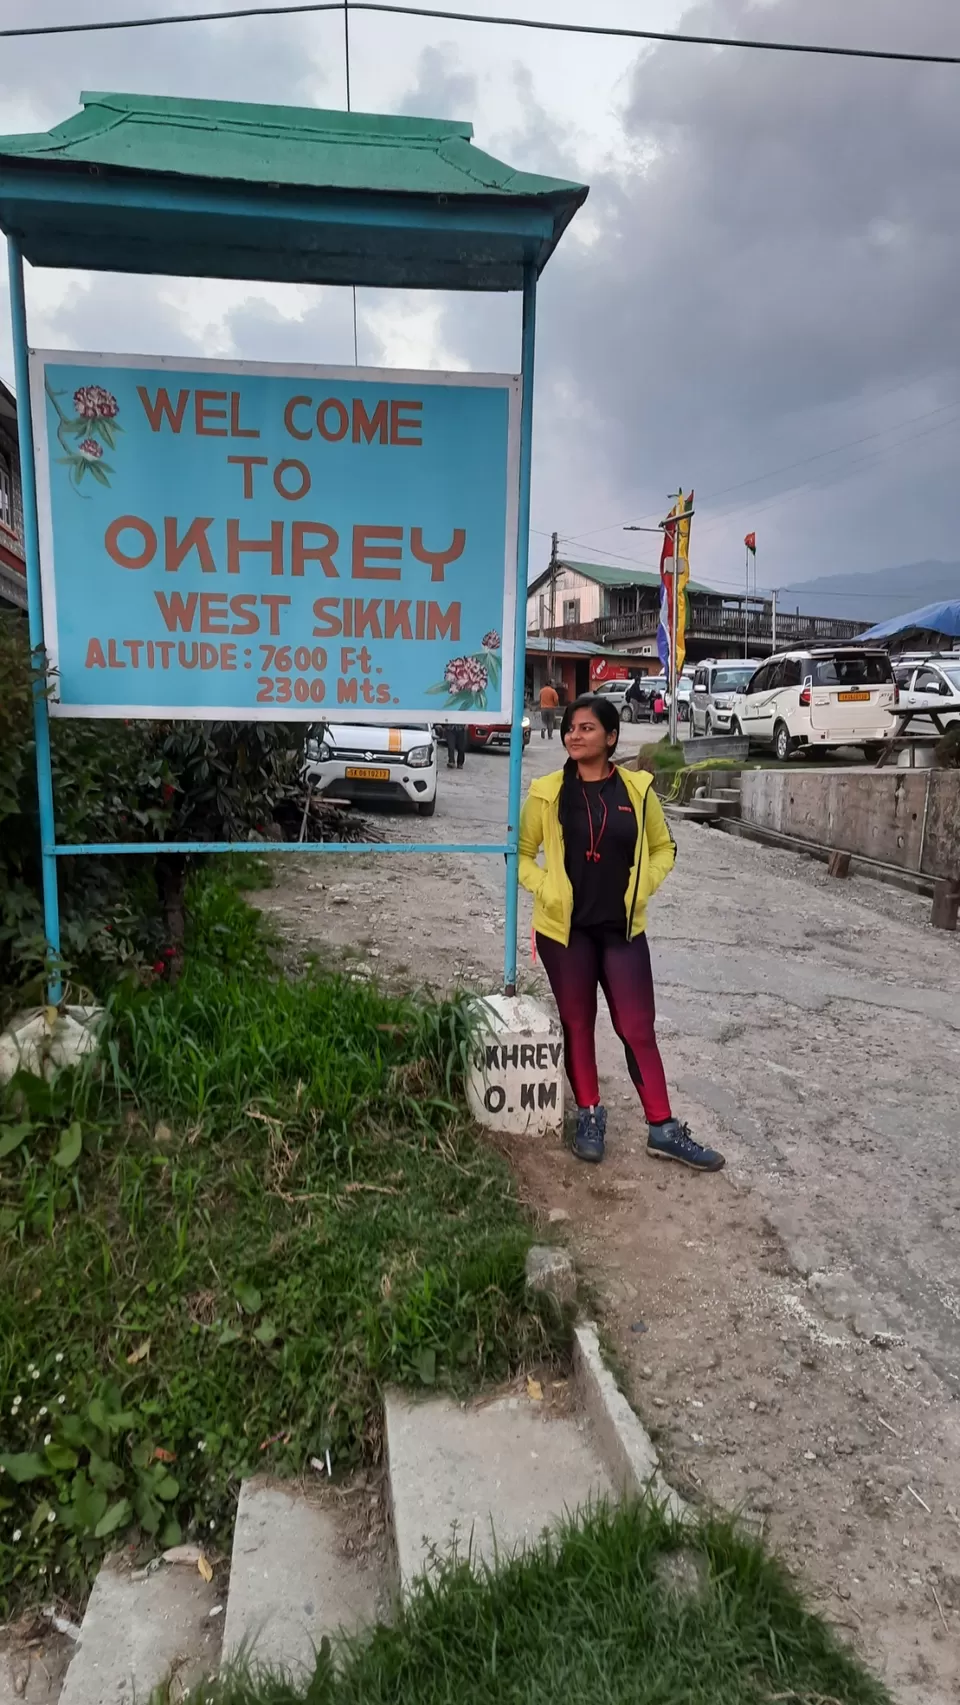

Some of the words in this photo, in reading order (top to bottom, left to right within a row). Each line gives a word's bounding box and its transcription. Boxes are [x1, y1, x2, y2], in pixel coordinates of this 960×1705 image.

[137, 386, 260, 438] WEL
[284, 396, 423, 446] COME
[228, 456, 312, 501] TO
[104, 515, 466, 582] OKHREY
[154, 591, 292, 636] WEST
[312, 597, 462, 641] SIKKIM
[260, 645, 328, 673] 7600
[341, 646, 383, 674] Ft.
[256, 677, 327, 704] 2300
[337, 677, 400, 704] Mts.
